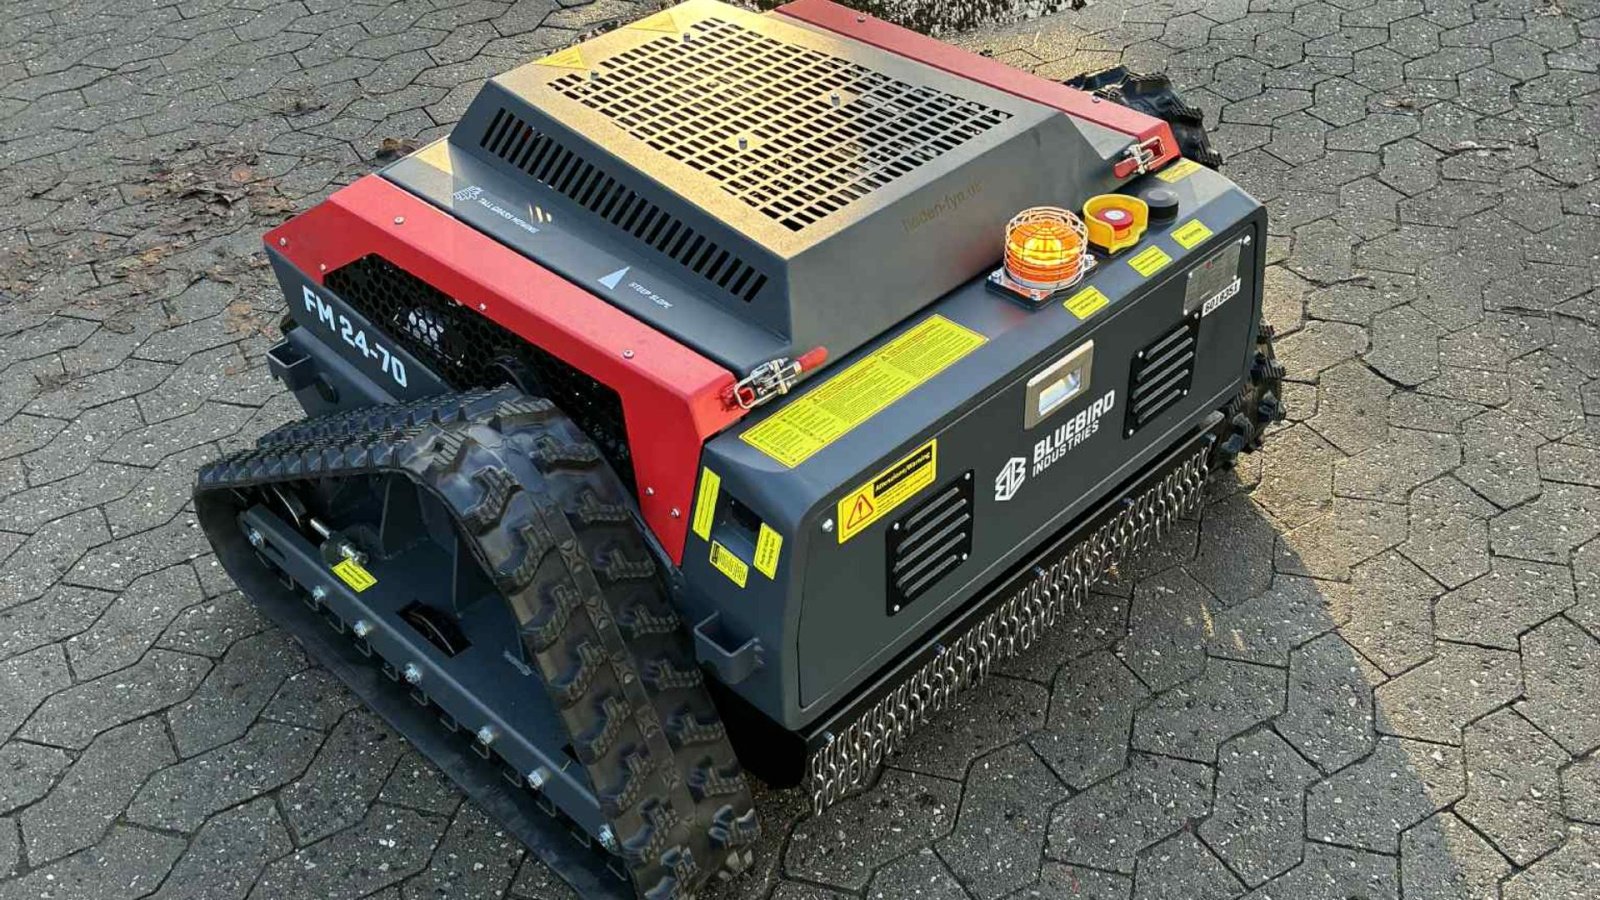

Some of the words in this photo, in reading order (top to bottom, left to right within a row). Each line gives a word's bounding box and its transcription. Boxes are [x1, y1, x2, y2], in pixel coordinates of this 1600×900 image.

[628, 282, 651, 296] STEEP
[649, 294, 673, 309] SLOPE
[302, 285, 336, 332] FM
[339, 315, 408, 389] 24-70
[1032, 420, 1100, 477] INDUSTRIES
[1033, 389, 1116, 464] BLUEBIRD
